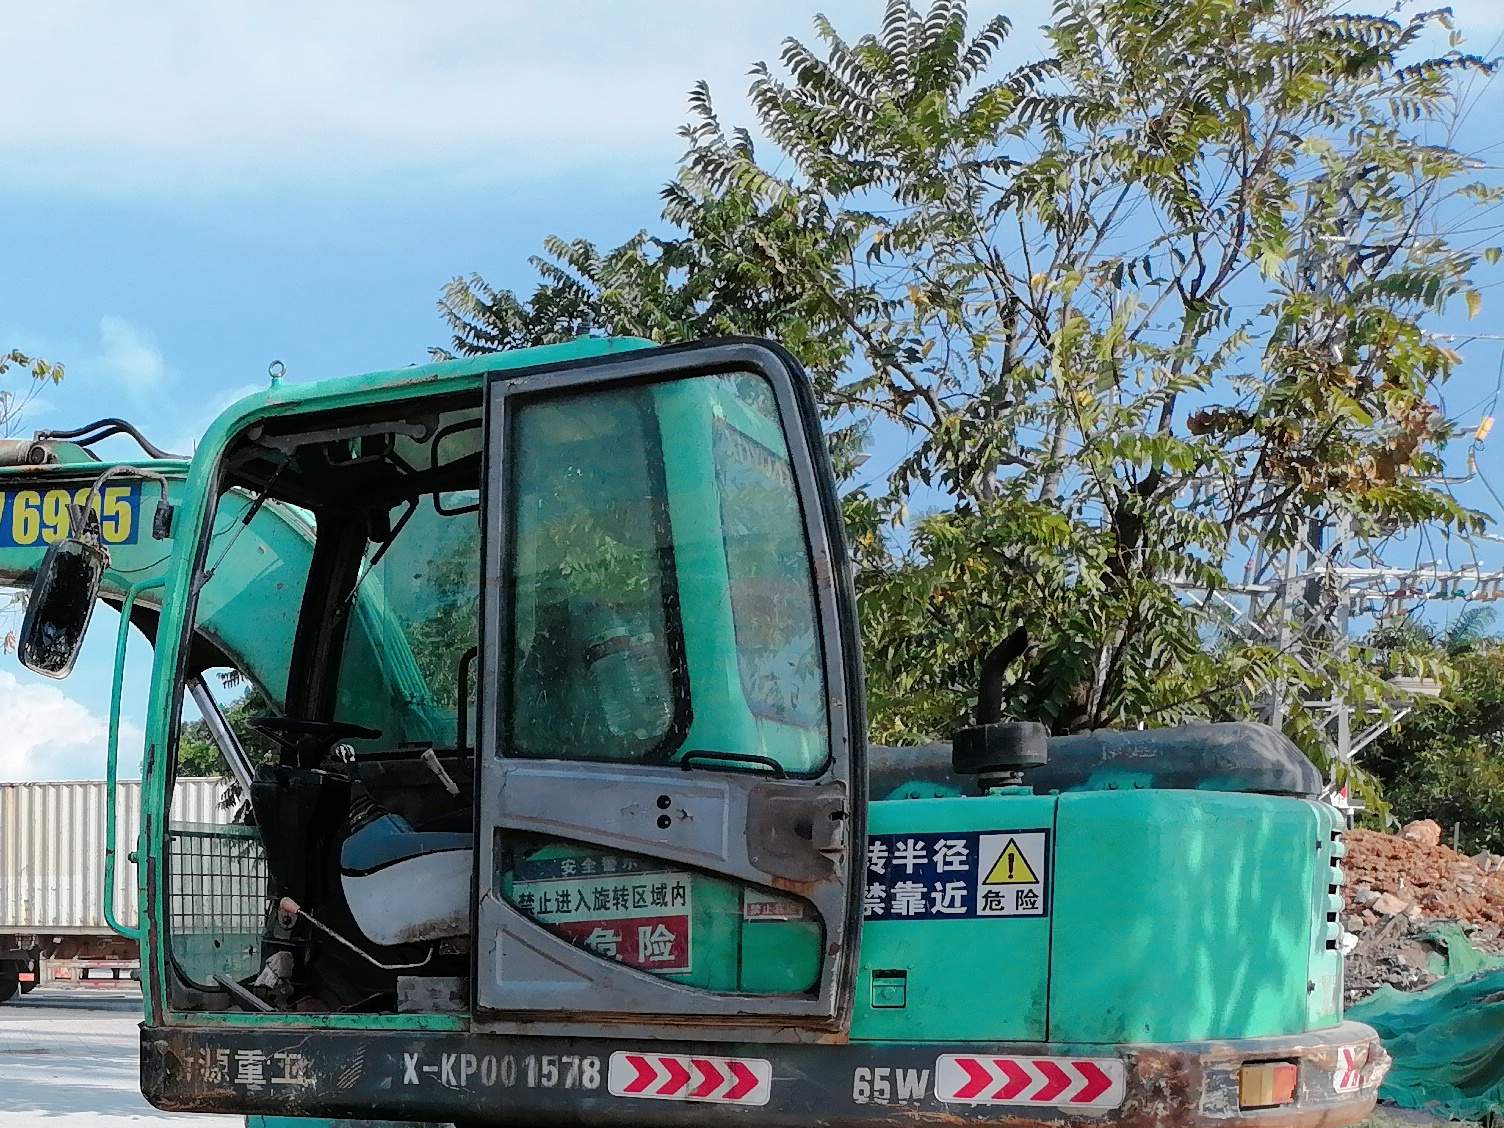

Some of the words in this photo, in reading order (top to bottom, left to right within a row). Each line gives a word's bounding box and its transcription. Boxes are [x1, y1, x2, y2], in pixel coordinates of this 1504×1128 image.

[517, 880, 687, 917] 禁止进入旋转区域内
[981, 888, 1040, 912] 危险
[583, 923, 677, 964] 危险
[852, 1066, 930, 1106] 65W
